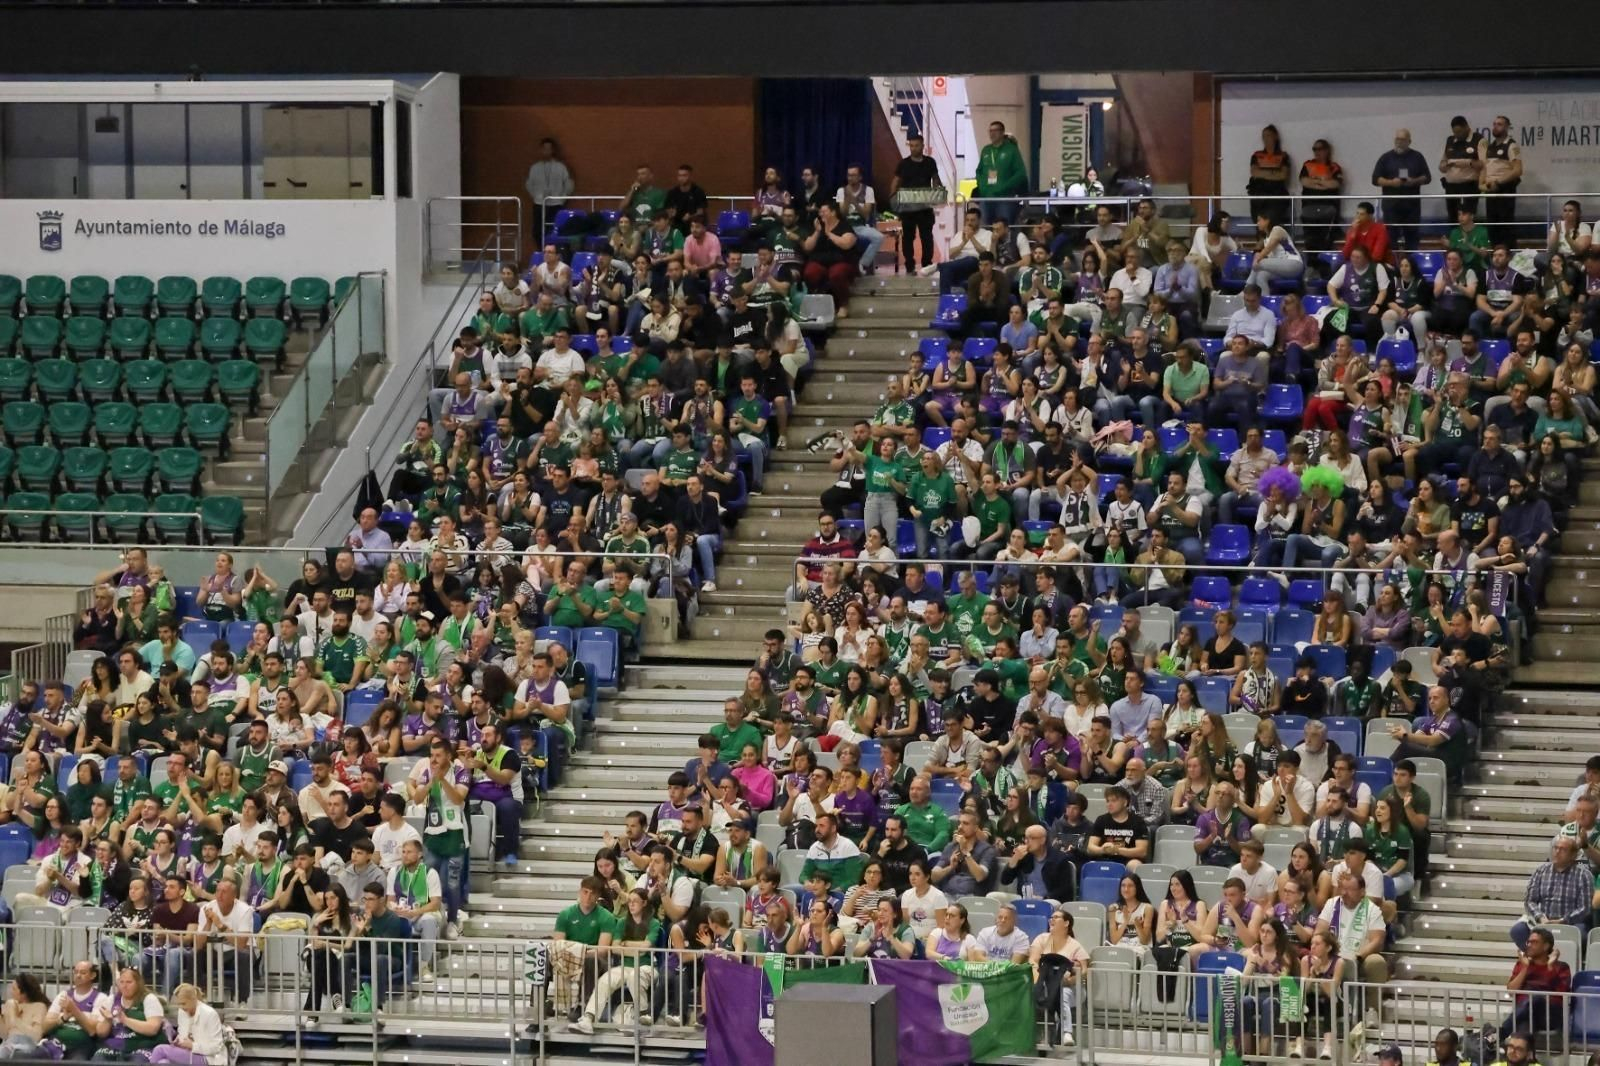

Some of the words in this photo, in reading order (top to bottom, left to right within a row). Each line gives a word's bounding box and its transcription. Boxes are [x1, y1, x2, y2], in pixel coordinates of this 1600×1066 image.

[1062, 114, 1083, 188] ONSIGNA
[74, 218, 192, 237] Ayuntamiento
[198, 219, 219, 235] de
[224, 218, 286, 239] Málaga
